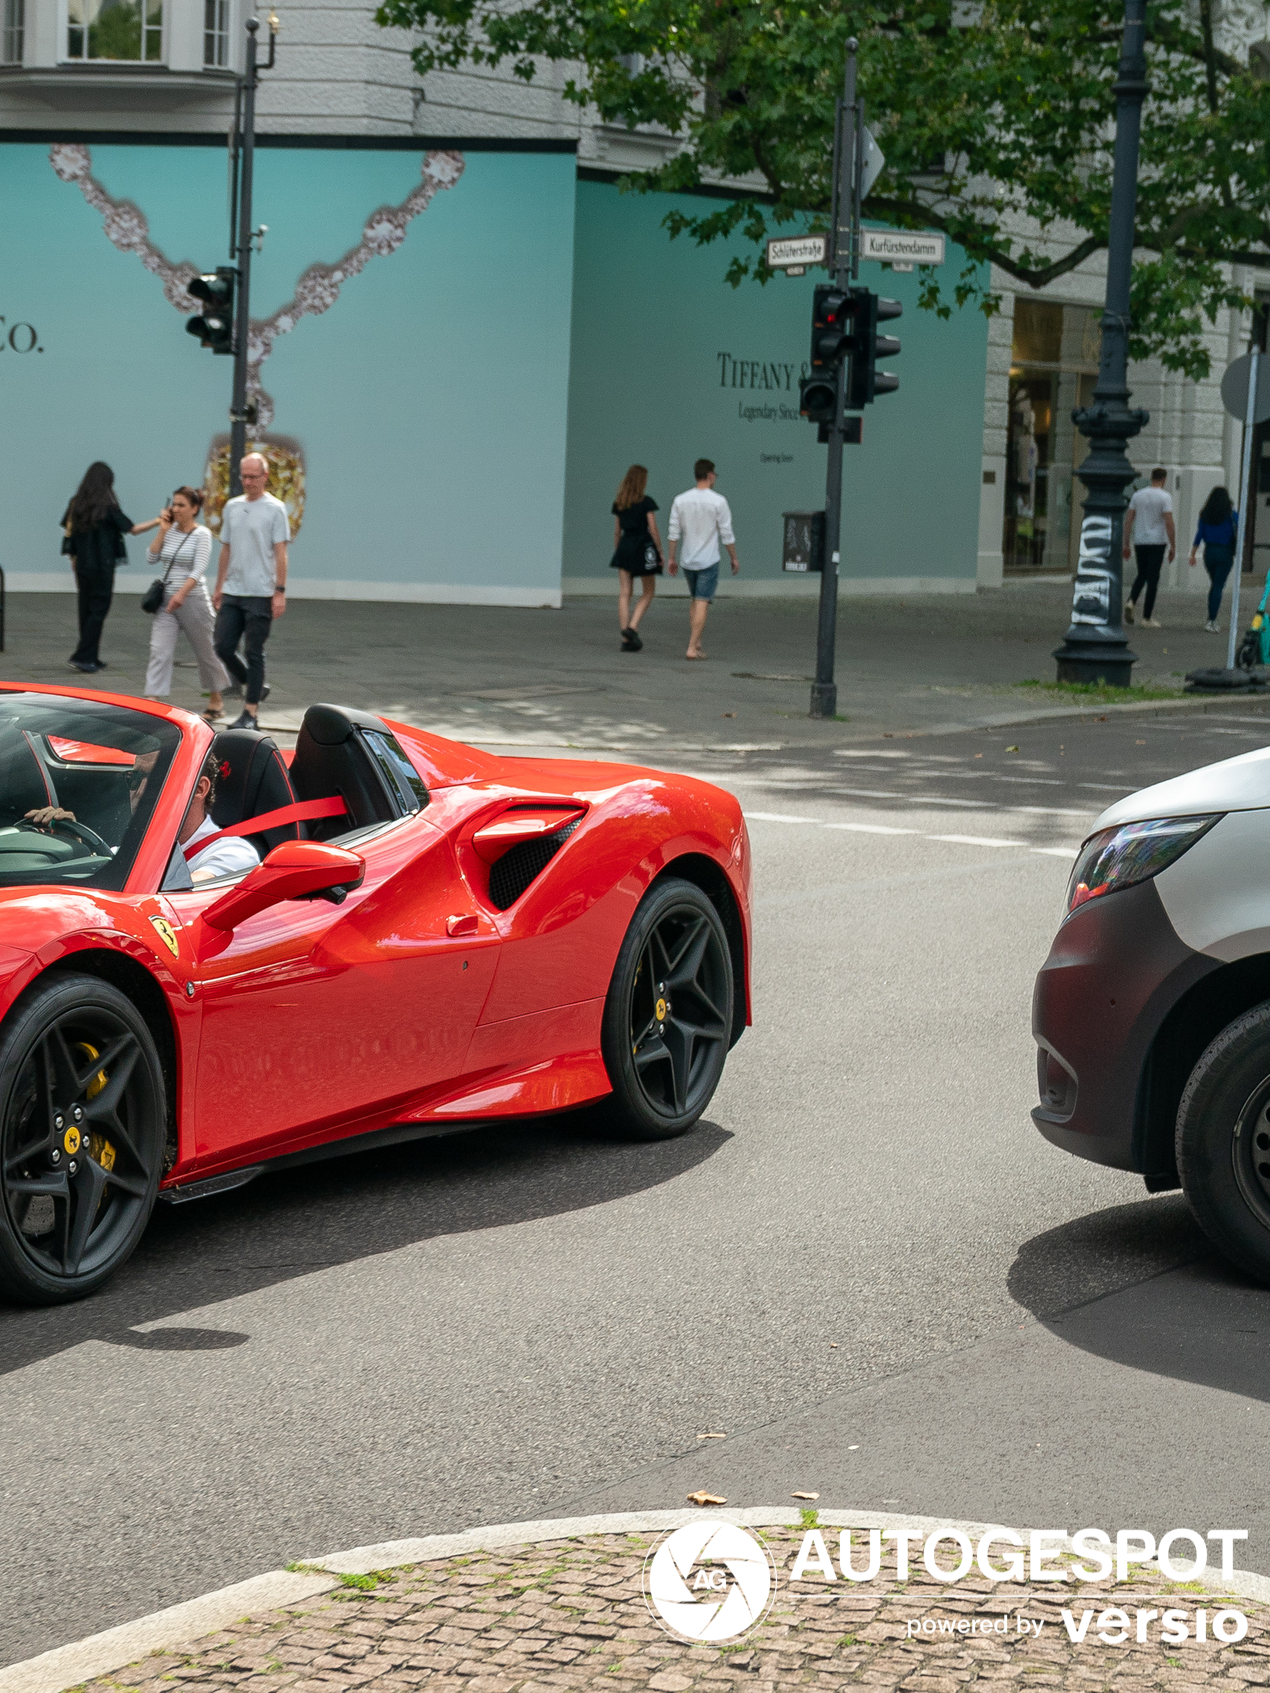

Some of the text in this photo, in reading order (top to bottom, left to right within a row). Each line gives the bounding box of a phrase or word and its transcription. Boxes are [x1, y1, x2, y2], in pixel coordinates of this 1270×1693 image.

[772, 240, 822, 260] Schlüterstraße
[869, 236, 937, 256] Kurfürstendamm
[716, 351, 796, 391] TIFFANY
